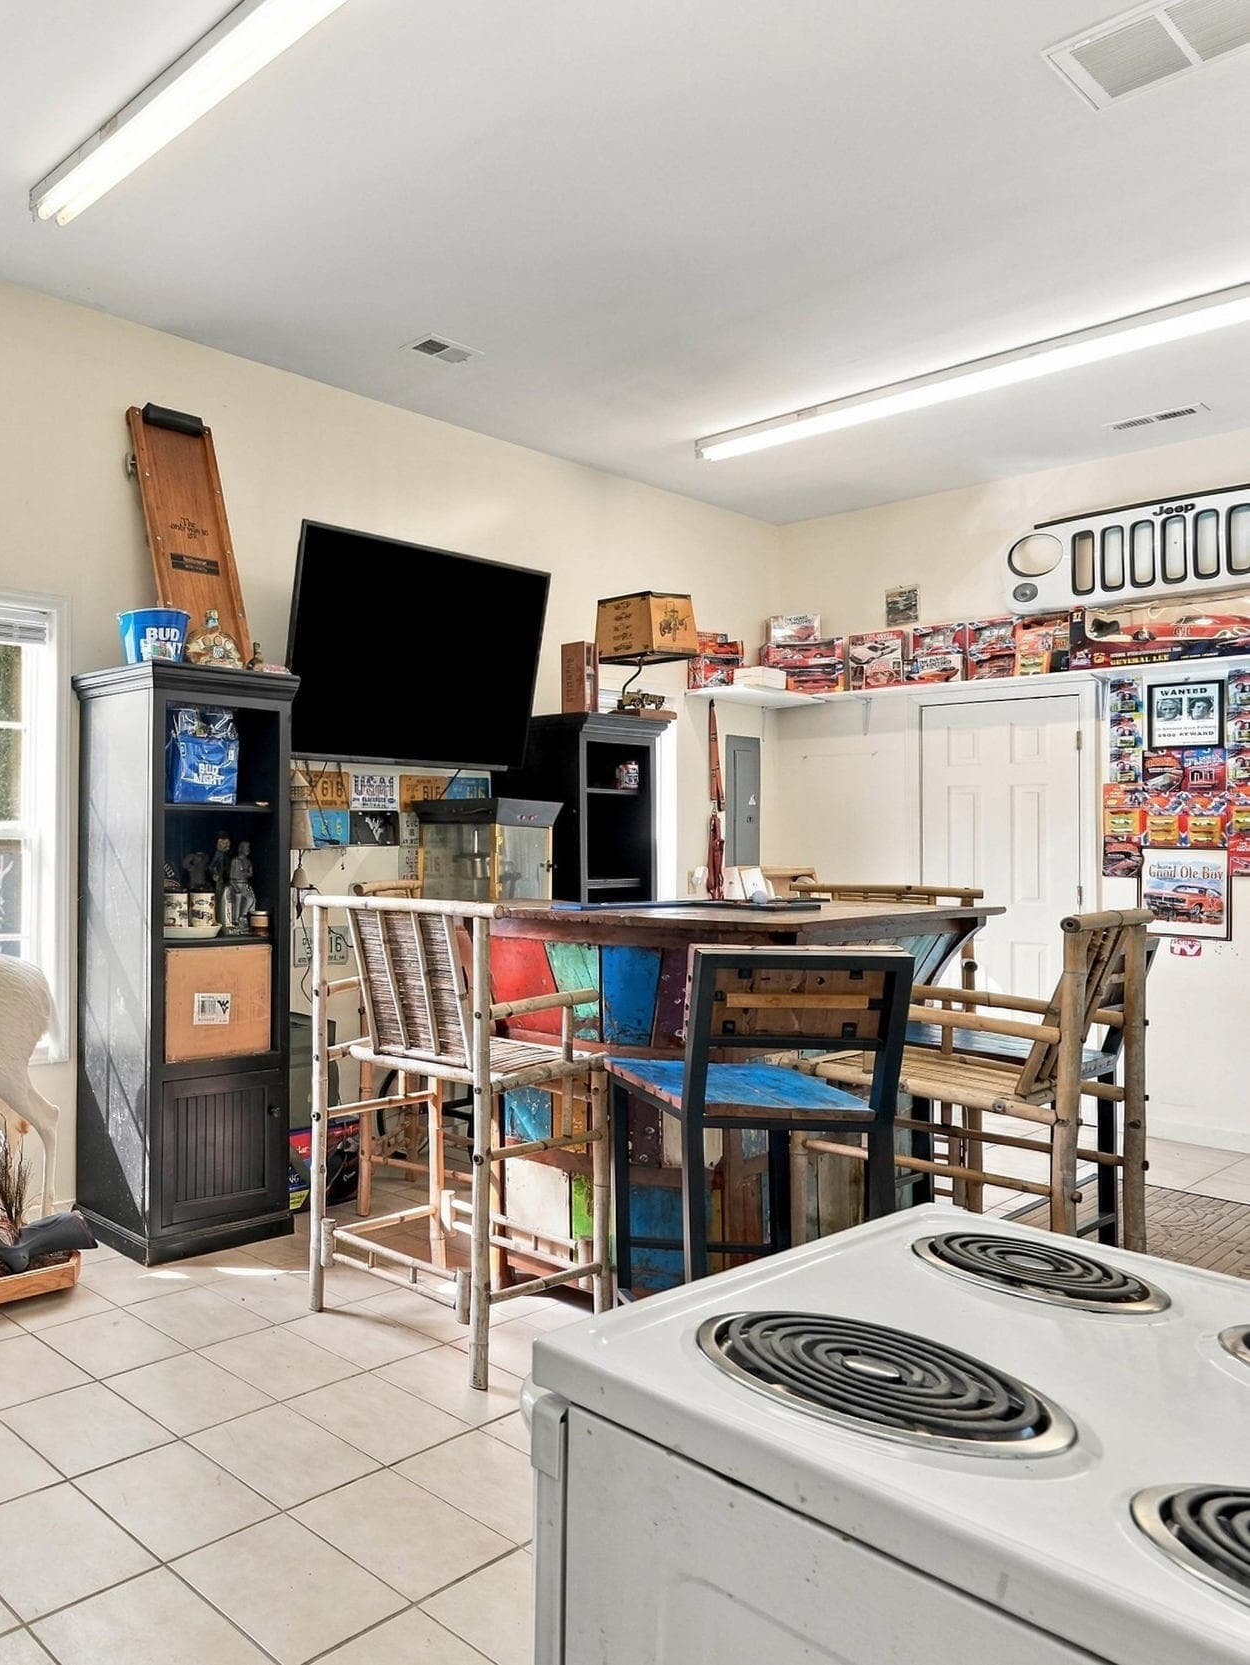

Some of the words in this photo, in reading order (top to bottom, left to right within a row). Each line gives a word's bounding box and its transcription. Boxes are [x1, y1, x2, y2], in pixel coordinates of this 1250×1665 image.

[1152, 503, 1195, 516] Jeep
[146, 628, 180, 642] BUD
[1160, 688, 1207, 696] WANTED
[198, 763, 219, 775] BUD
[1149, 865, 1176, 878] Good
[1180, 866, 1198, 877] Ole
[1202, 867, 1223, 880] Boy
[1174, 945, 1200, 957] TV
